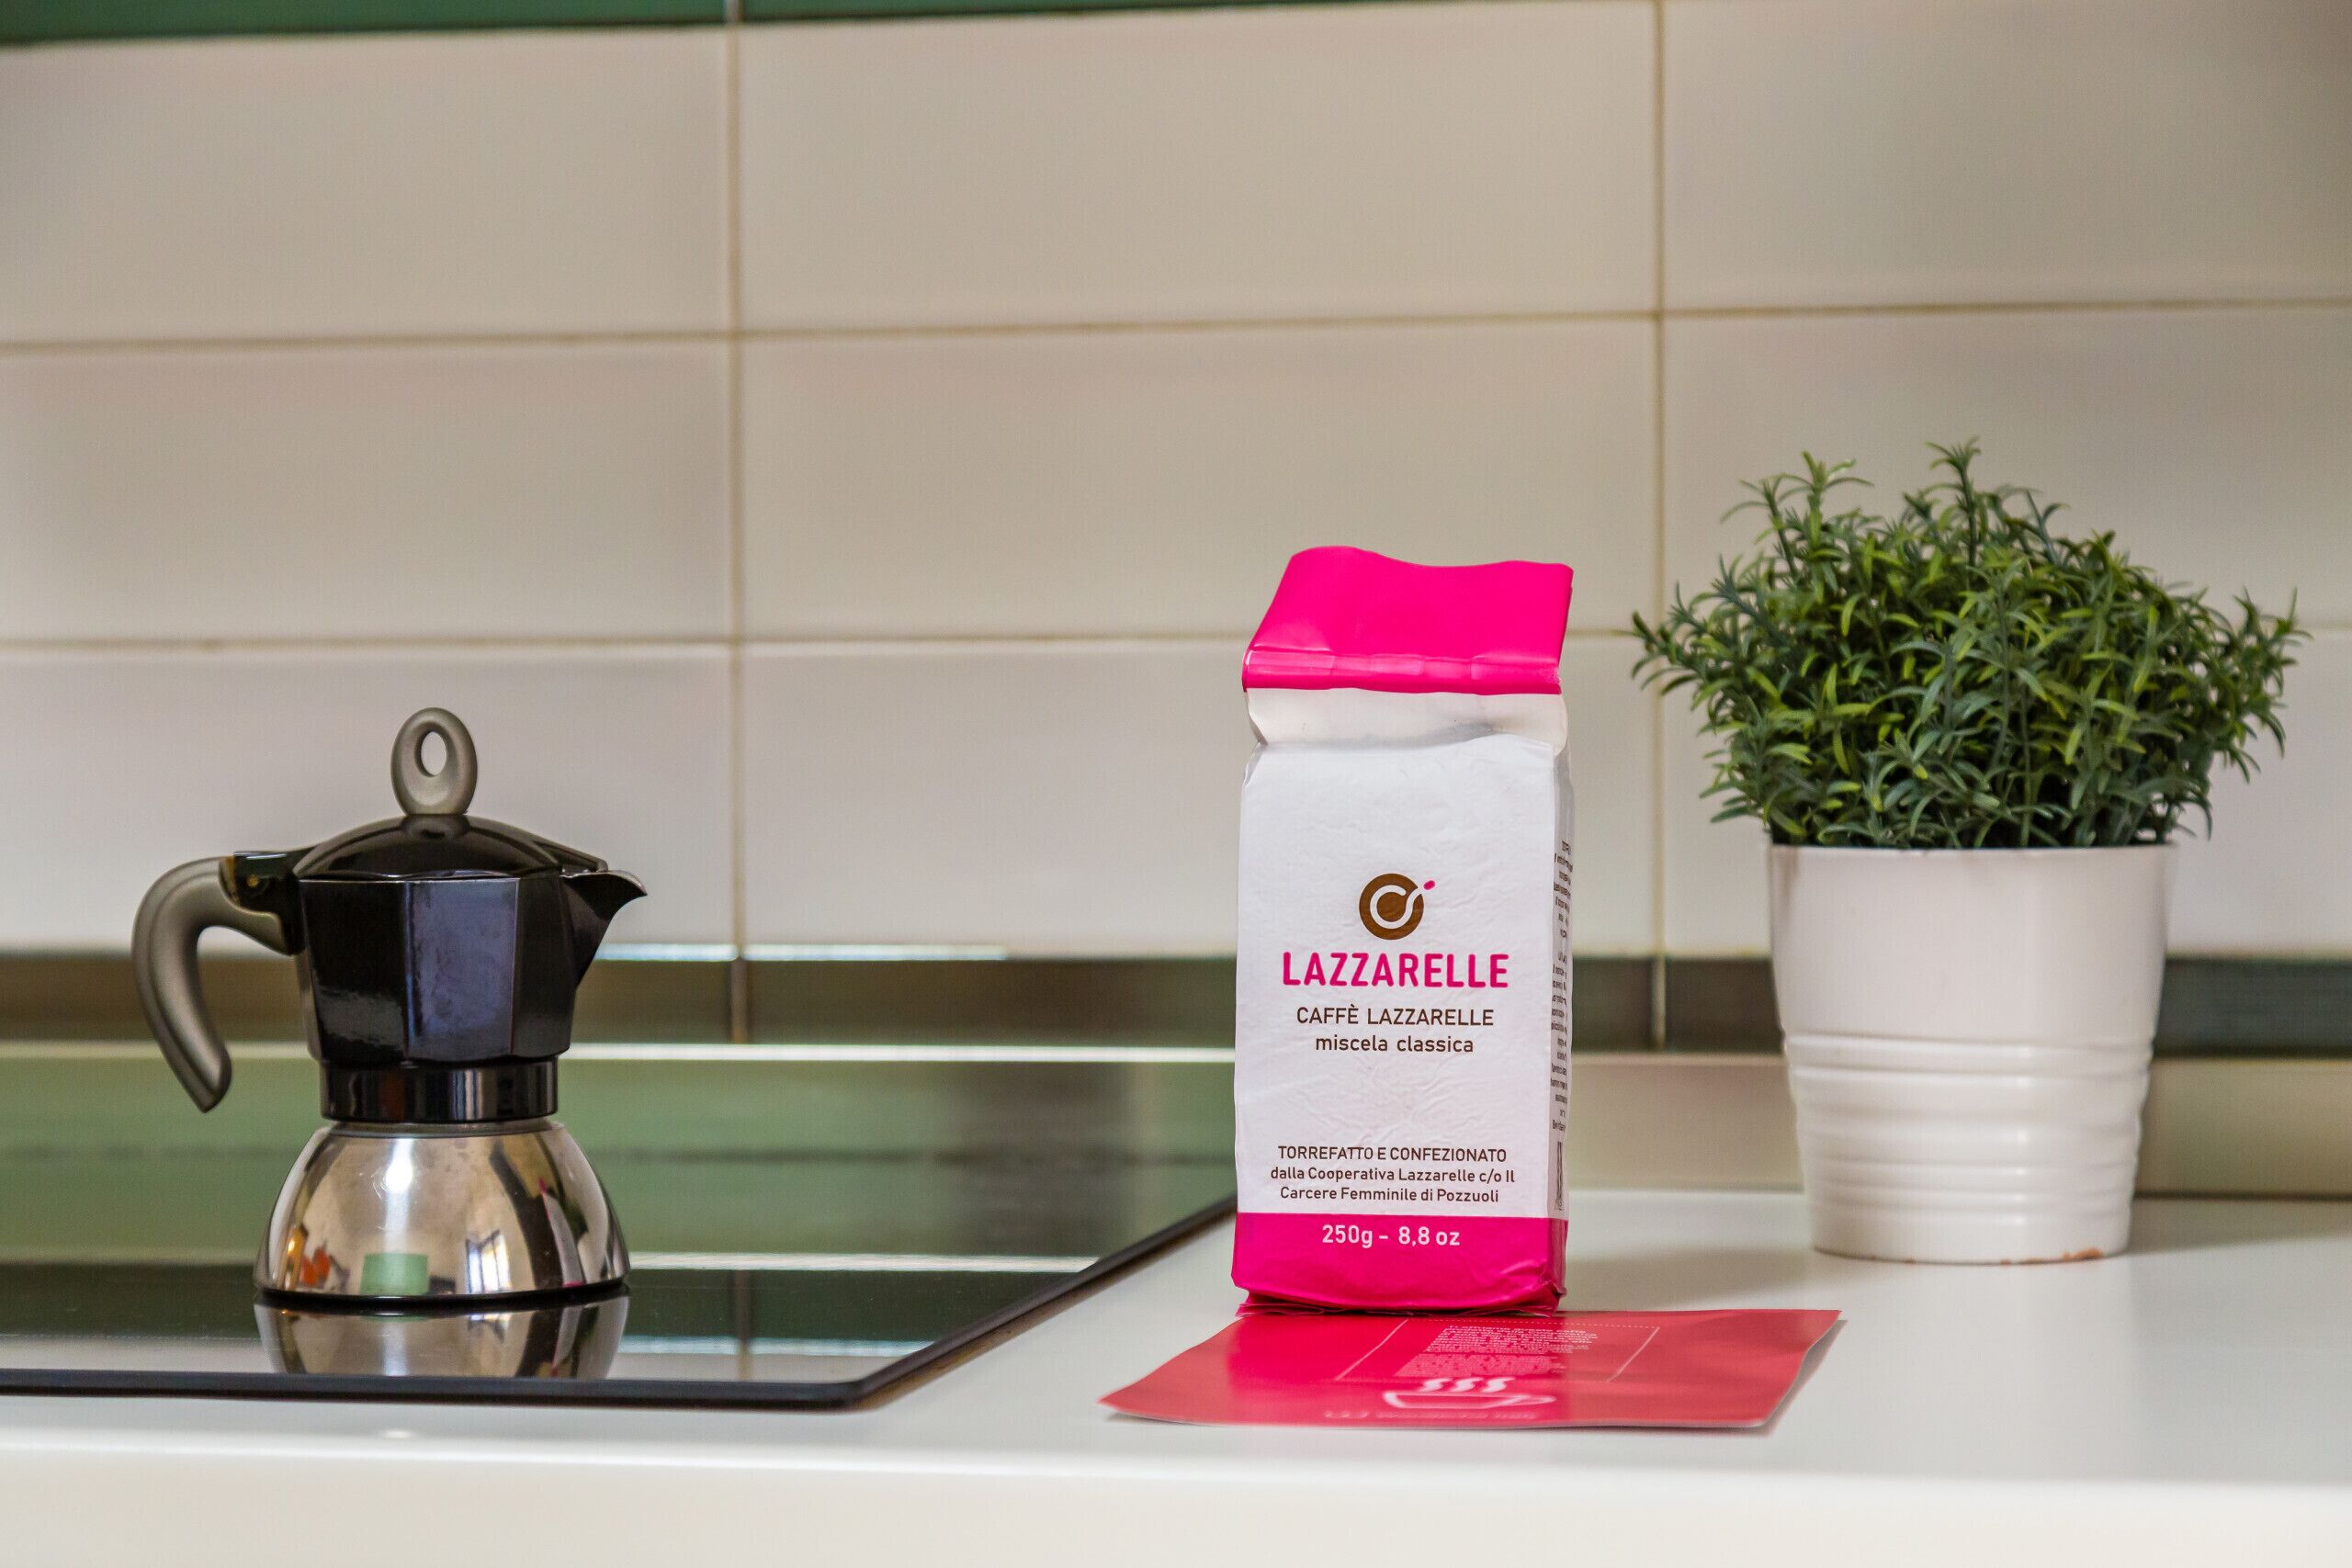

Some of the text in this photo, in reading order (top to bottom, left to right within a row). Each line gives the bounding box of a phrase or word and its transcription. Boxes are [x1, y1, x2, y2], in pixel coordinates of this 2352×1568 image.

[1283, 952, 1510, 988] LAZZARELLE
[1296, 1003, 1494, 1026] CAFFÈ LAZZARELLE
[1316, 1034, 1474, 1053] miscela classica
[1278, 1145, 1507, 1162] TORREFATTO E CONFEZIONATO
[1270, 1166, 1304, 1179] dalla
[1307, 1167, 1395, 1183] Cooperativa
[1398, 1168, 1476, 1182] Lazzarelle
[1478, 1168, 1502, 1184] c/o
[1280, 1186, 1499, 1202] Carcere Femminile di Pozzuoli
[1322, 1224, 1373, 1248] 250g
[1398, 1226, 1430, 1247] 8,8
[1436, 1231, 1460, 1246] oz
